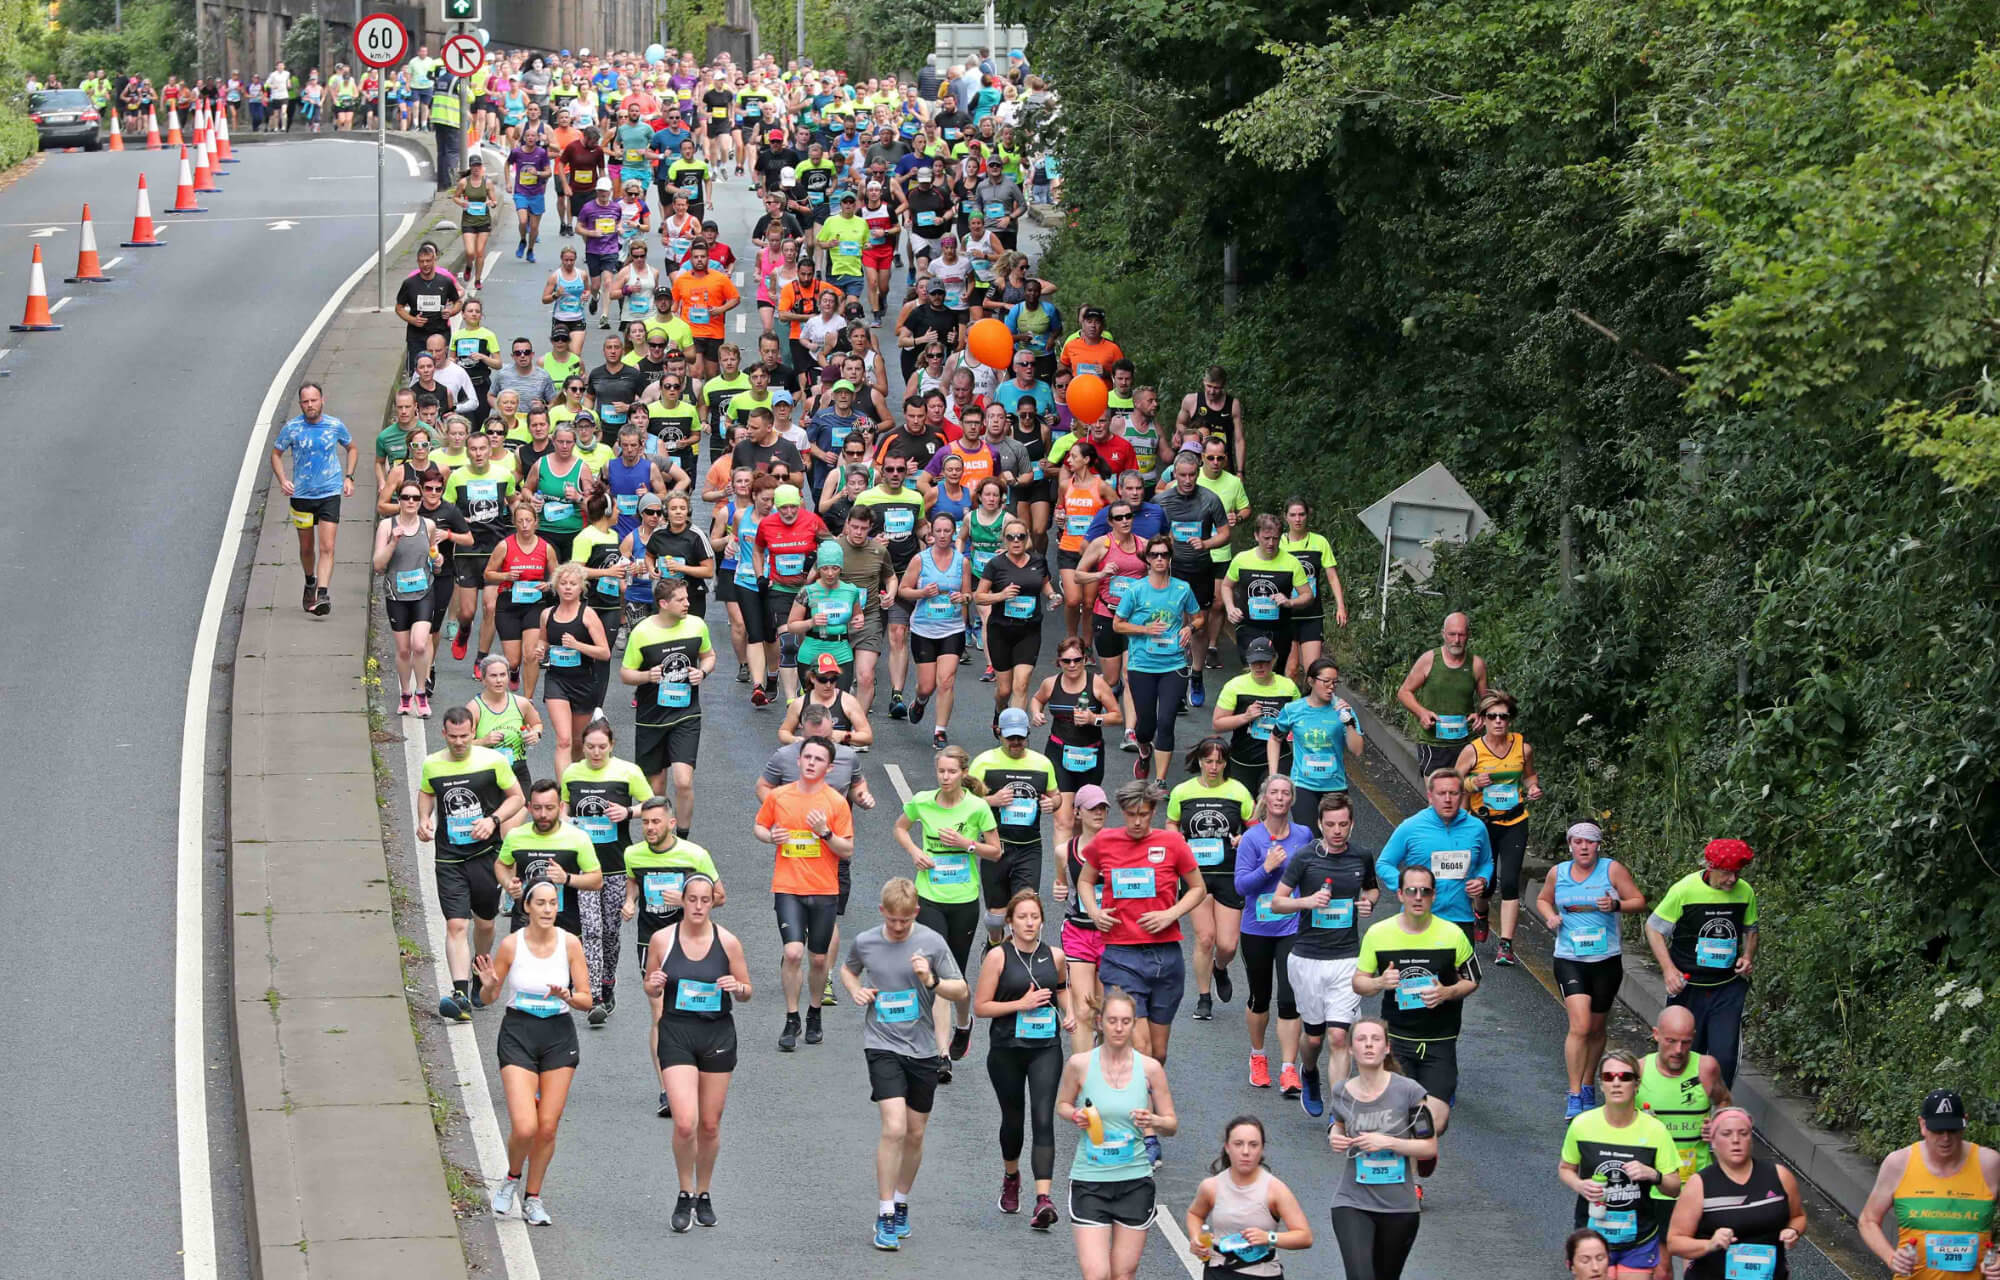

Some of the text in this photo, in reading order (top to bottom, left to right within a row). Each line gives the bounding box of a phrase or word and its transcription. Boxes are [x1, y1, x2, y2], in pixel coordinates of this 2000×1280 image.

[368, 27, 392, 49] 60
[1066, 498, 1093, 507] PACER
[1354, 1109, 1394, 1132] NIKE
